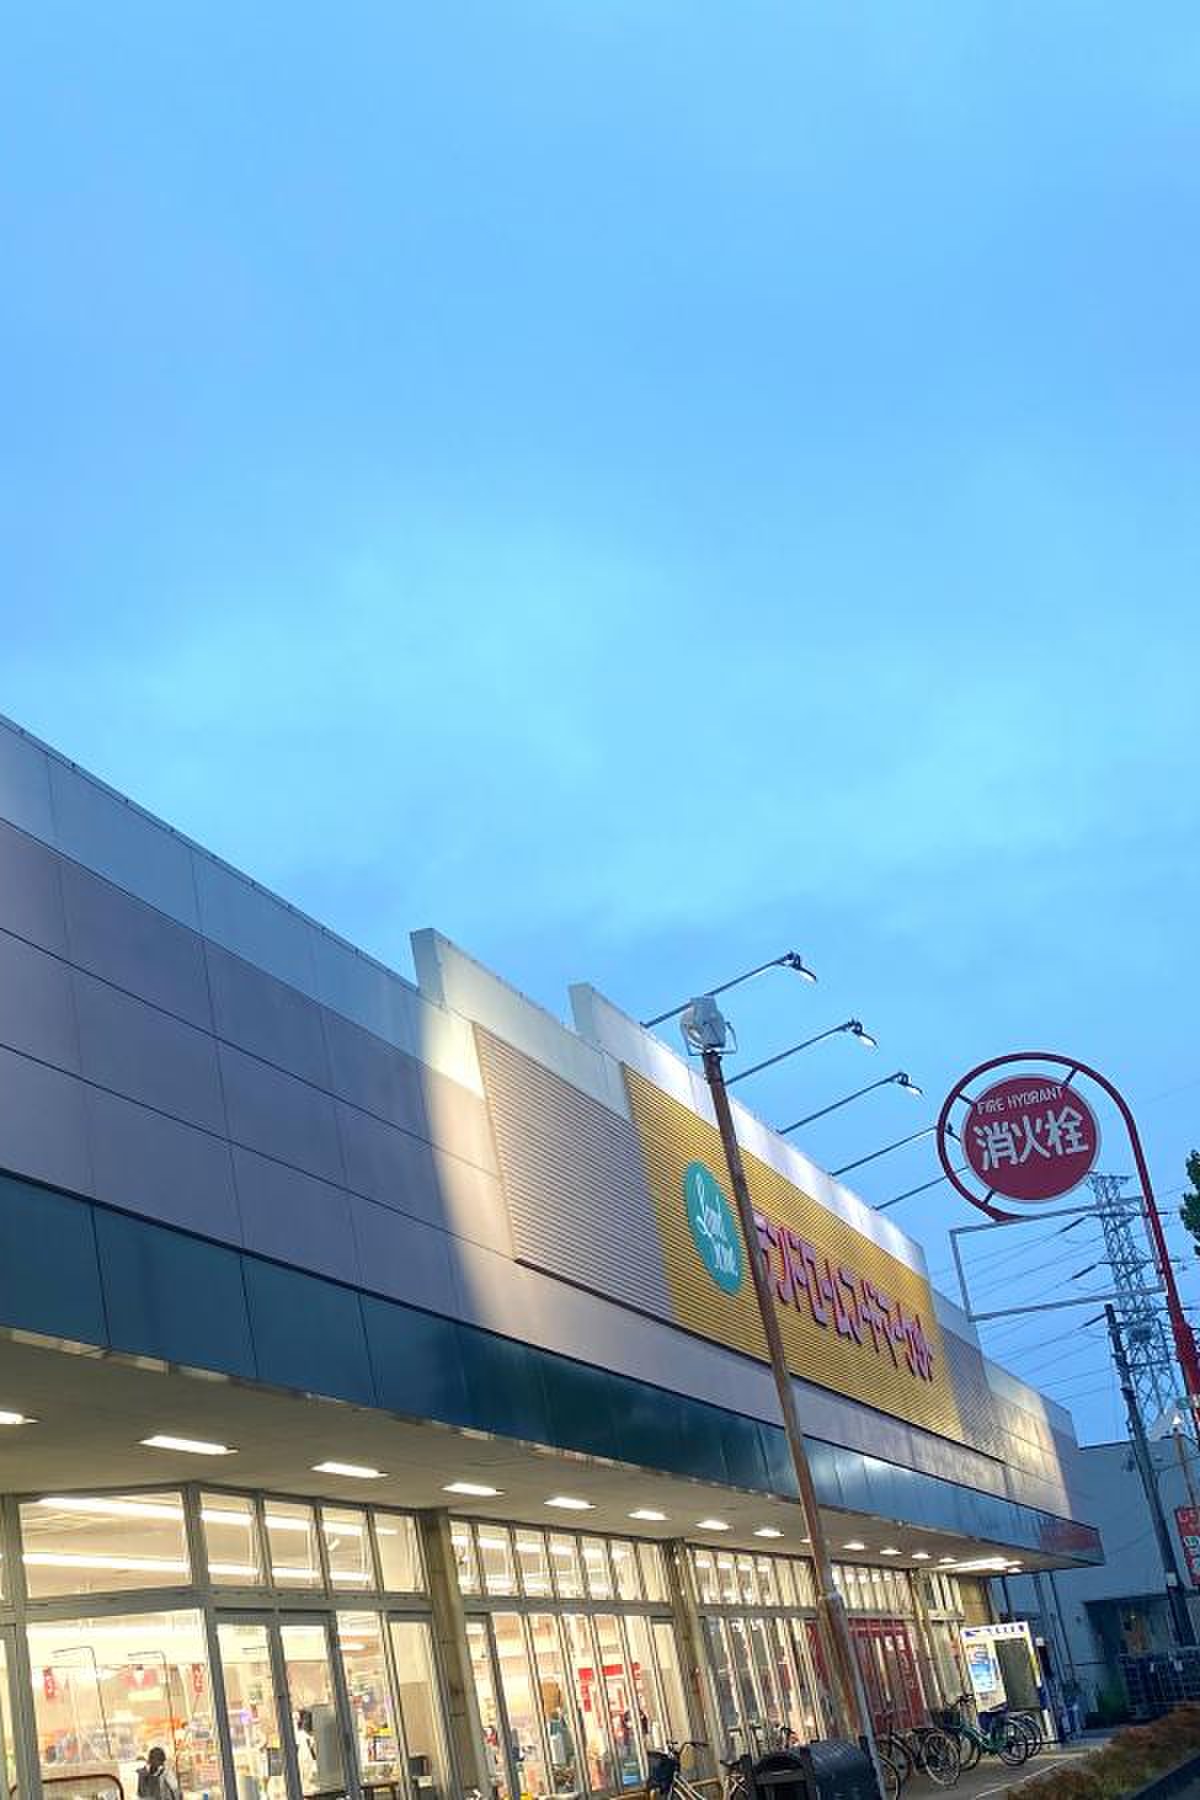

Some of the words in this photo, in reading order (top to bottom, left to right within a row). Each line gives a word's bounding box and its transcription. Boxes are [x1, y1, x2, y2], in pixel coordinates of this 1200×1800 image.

[976, 1098, 1005, 1115] FIRE
[1007, 1087, 1064, 1109] HYDRANT
[973, 1105, 1089, 1171] 消火栓
